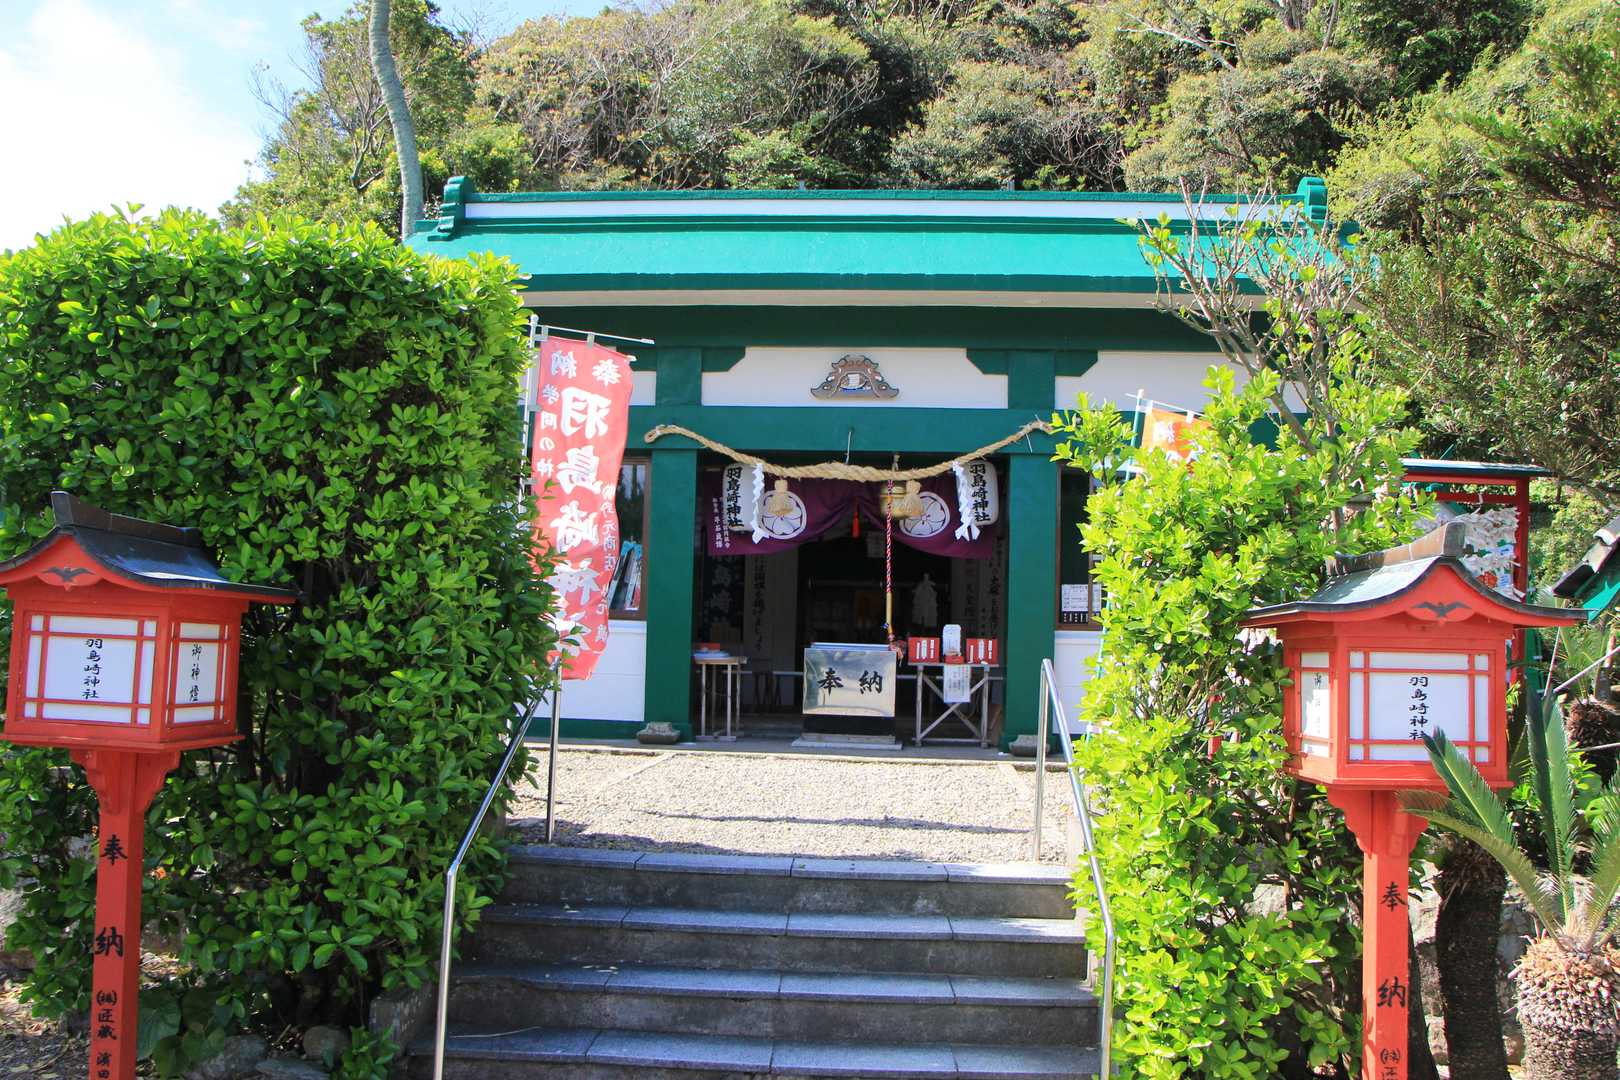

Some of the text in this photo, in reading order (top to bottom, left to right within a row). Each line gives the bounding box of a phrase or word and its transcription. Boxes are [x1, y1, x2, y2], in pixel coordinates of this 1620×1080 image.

[969, 463, 991, 523] 羽島崎神社
[82, 638, 103, 700] 羽島崎神社
[817, 667, 883, 697] 奉納
[1408, 676, 1429, 741] 羽島崎神社
